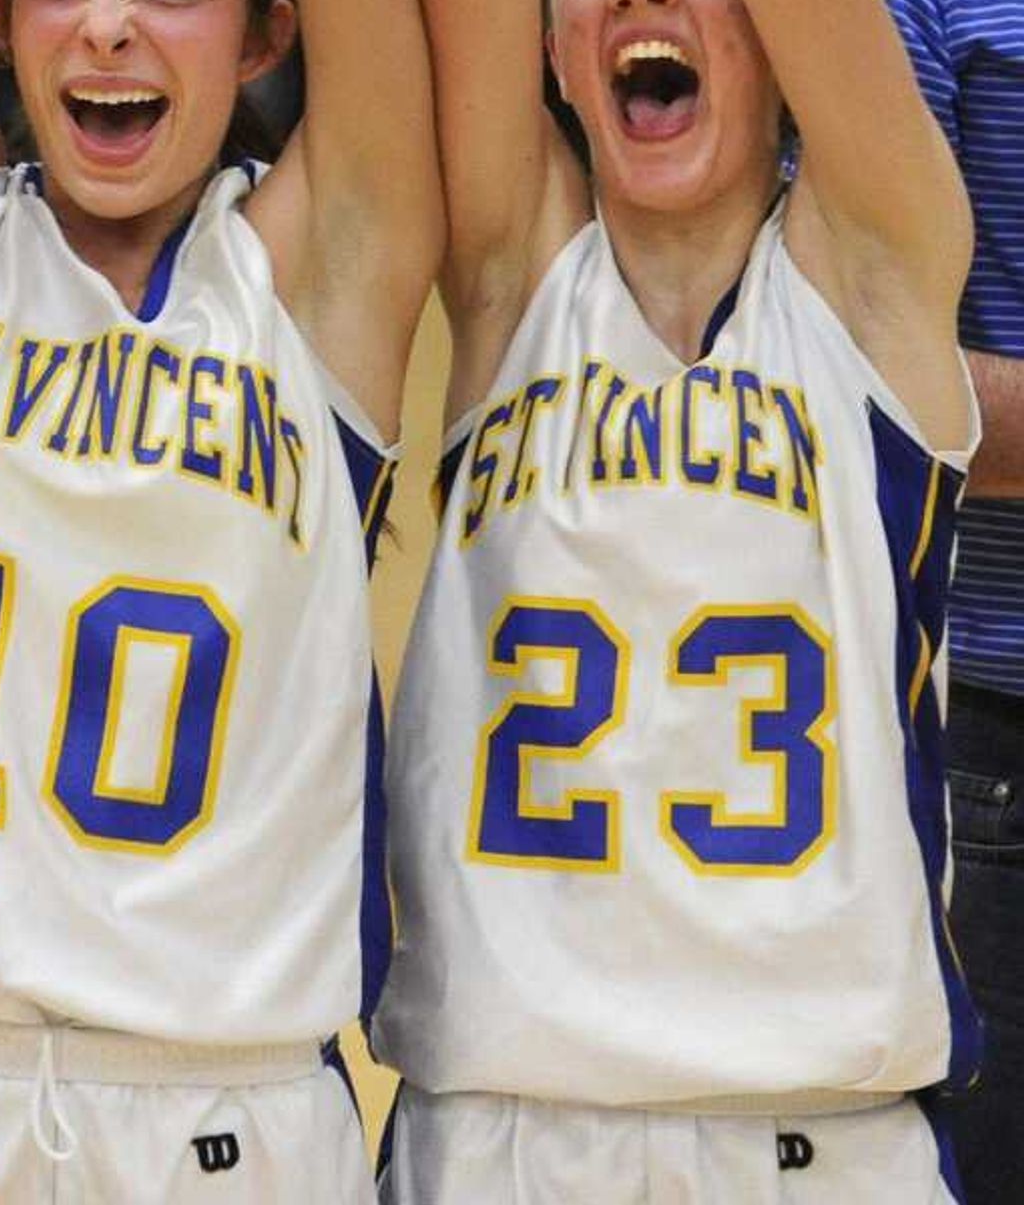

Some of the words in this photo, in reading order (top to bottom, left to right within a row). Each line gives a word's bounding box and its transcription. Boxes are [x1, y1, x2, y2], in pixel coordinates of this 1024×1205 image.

[0, 326, 309, 552] VINCENT
[460, 372, 568, 548] ST.
[563, 356, 824, 536] INCEN
[465, 596, 838, 877] 23
